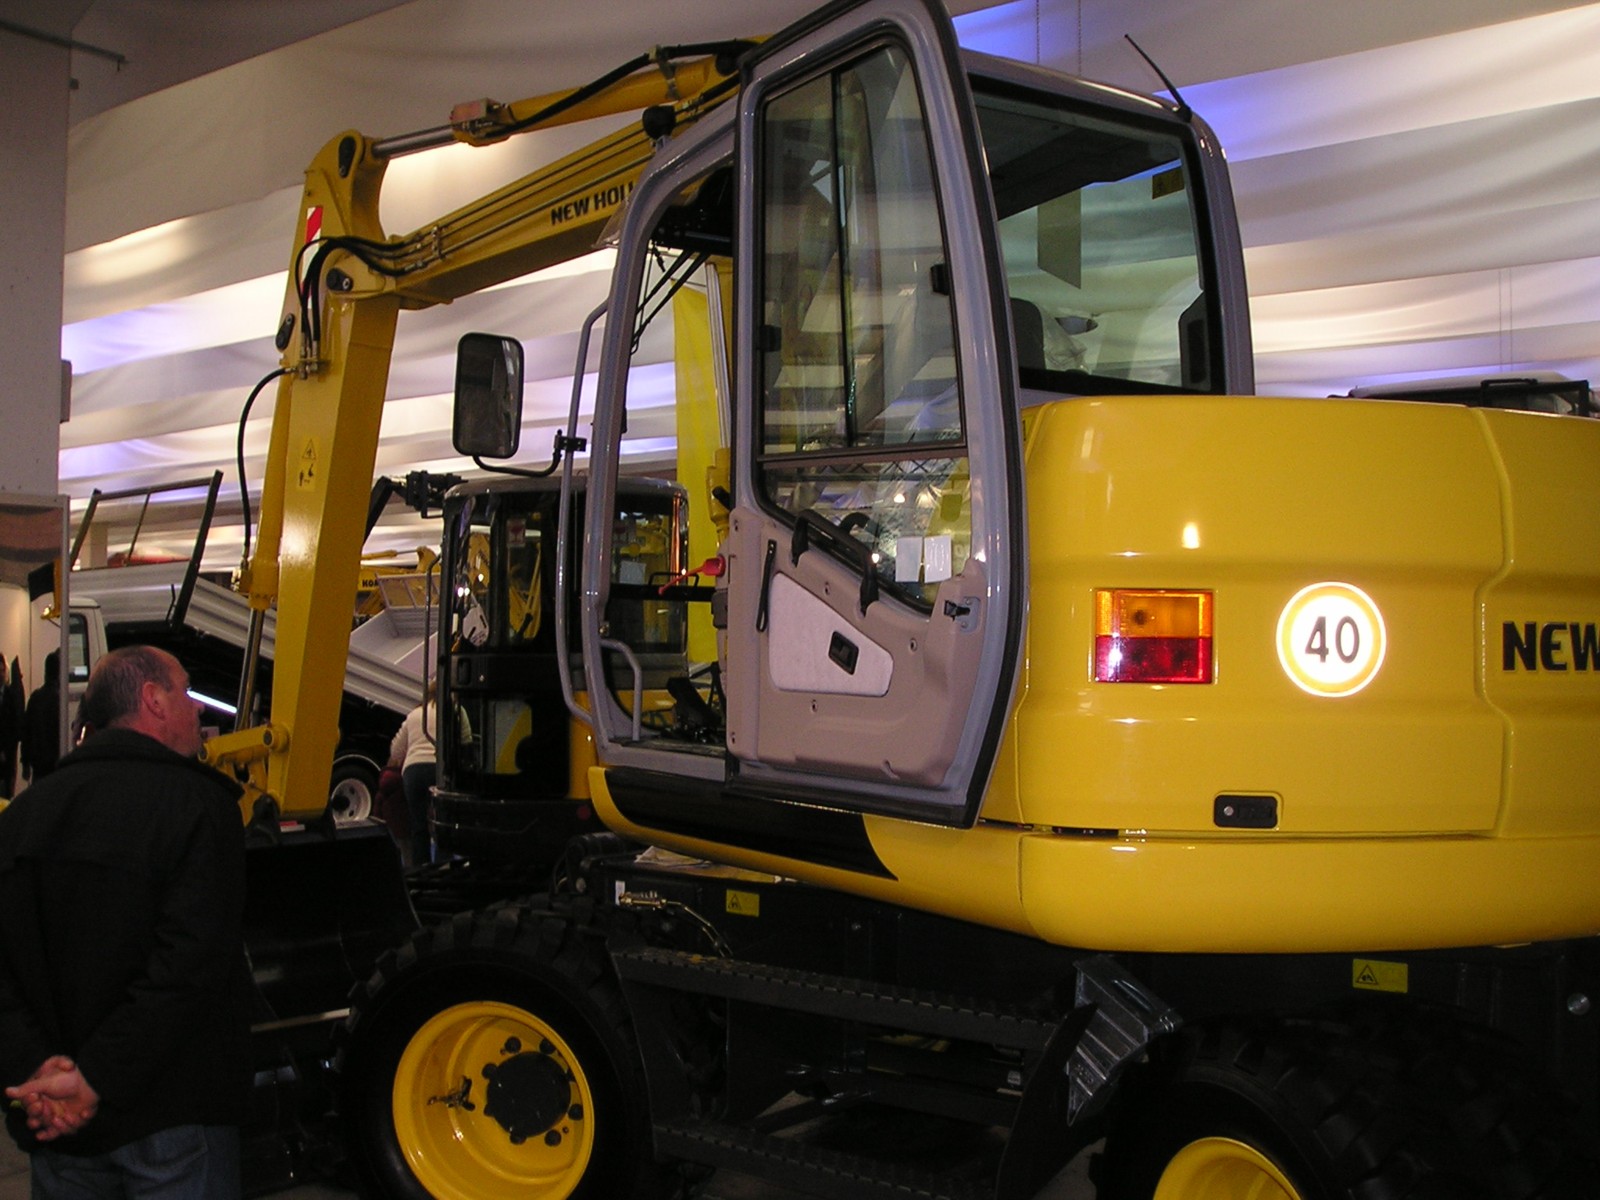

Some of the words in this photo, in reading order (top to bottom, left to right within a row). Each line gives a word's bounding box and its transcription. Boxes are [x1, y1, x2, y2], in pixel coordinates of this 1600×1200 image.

[551, 197, 589, 226] NEW
[1305, 616, 1360, 664] 40
[1502, 621, 1600, 672] NEW
